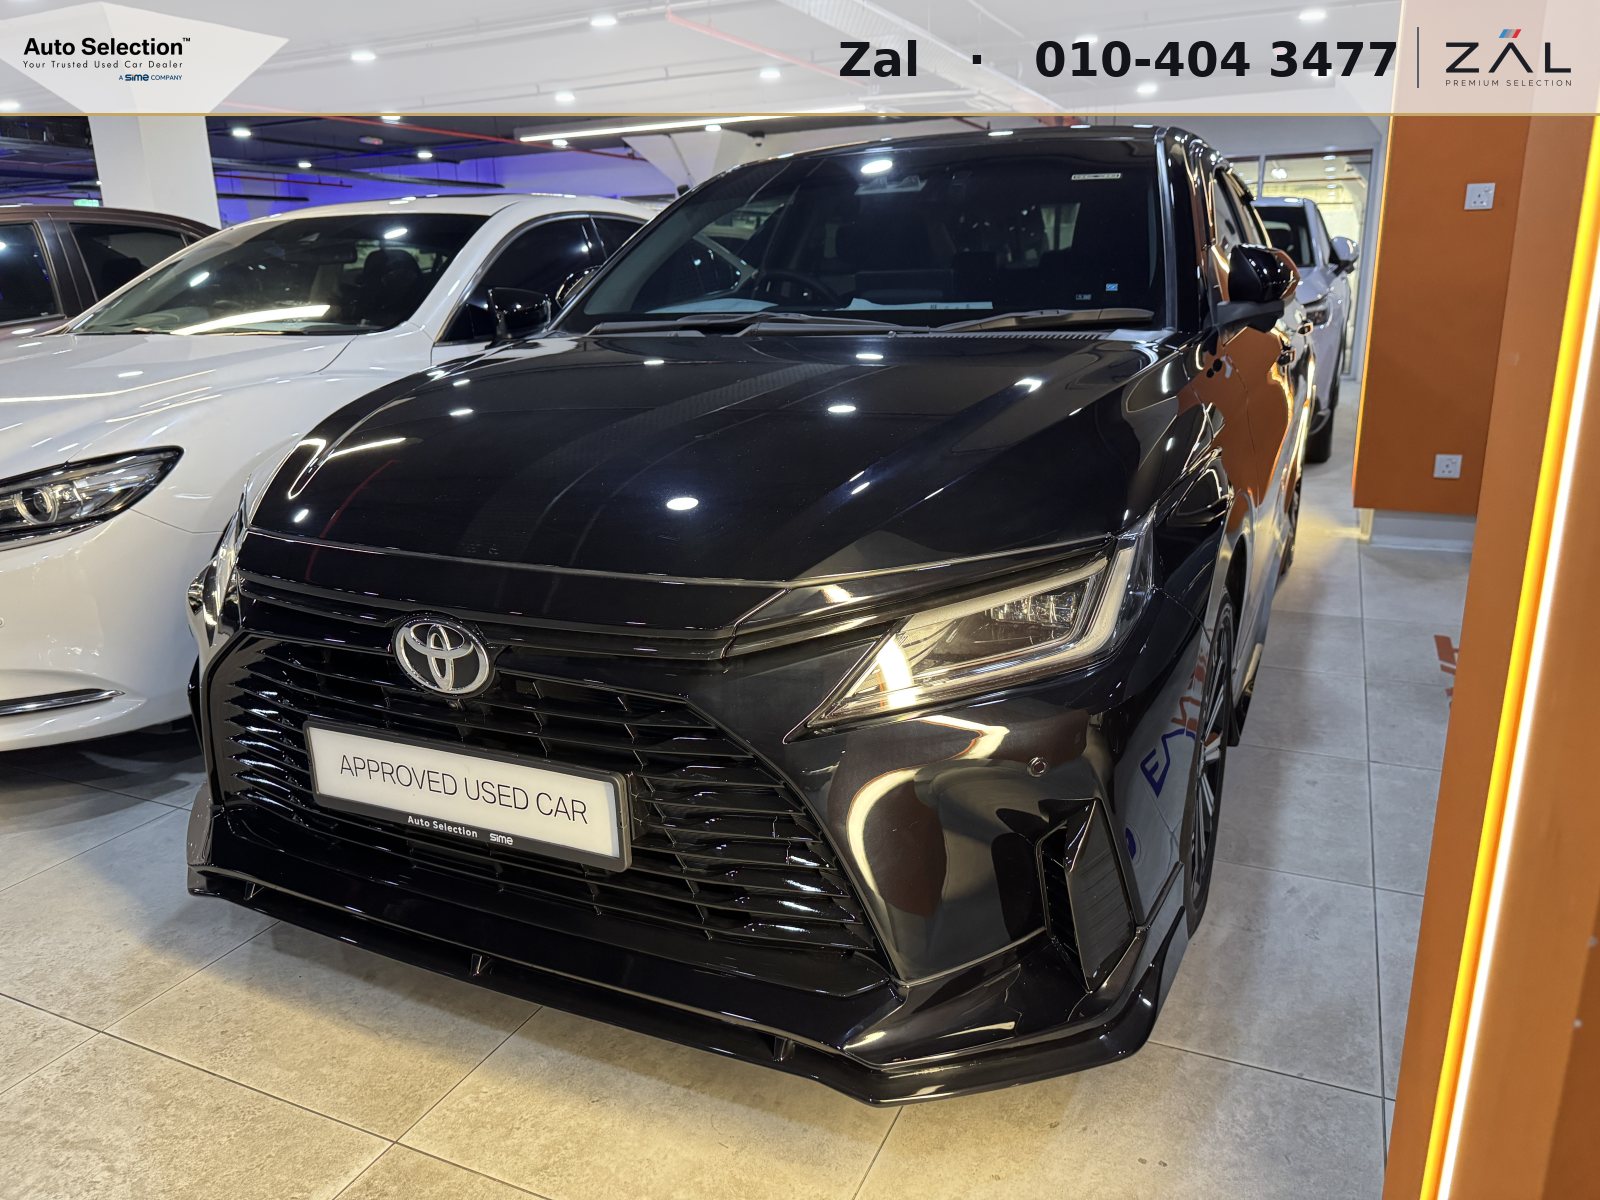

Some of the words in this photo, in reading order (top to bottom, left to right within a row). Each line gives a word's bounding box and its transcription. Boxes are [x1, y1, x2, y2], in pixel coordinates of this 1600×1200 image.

[340, 754, 458, 796] APPROVED
[465, 778, 529, 811] USED
[536, 792, 589, 825] CAR
[407, 815, 430, 827] Auto
[433, 820, 478, 838] Selection
